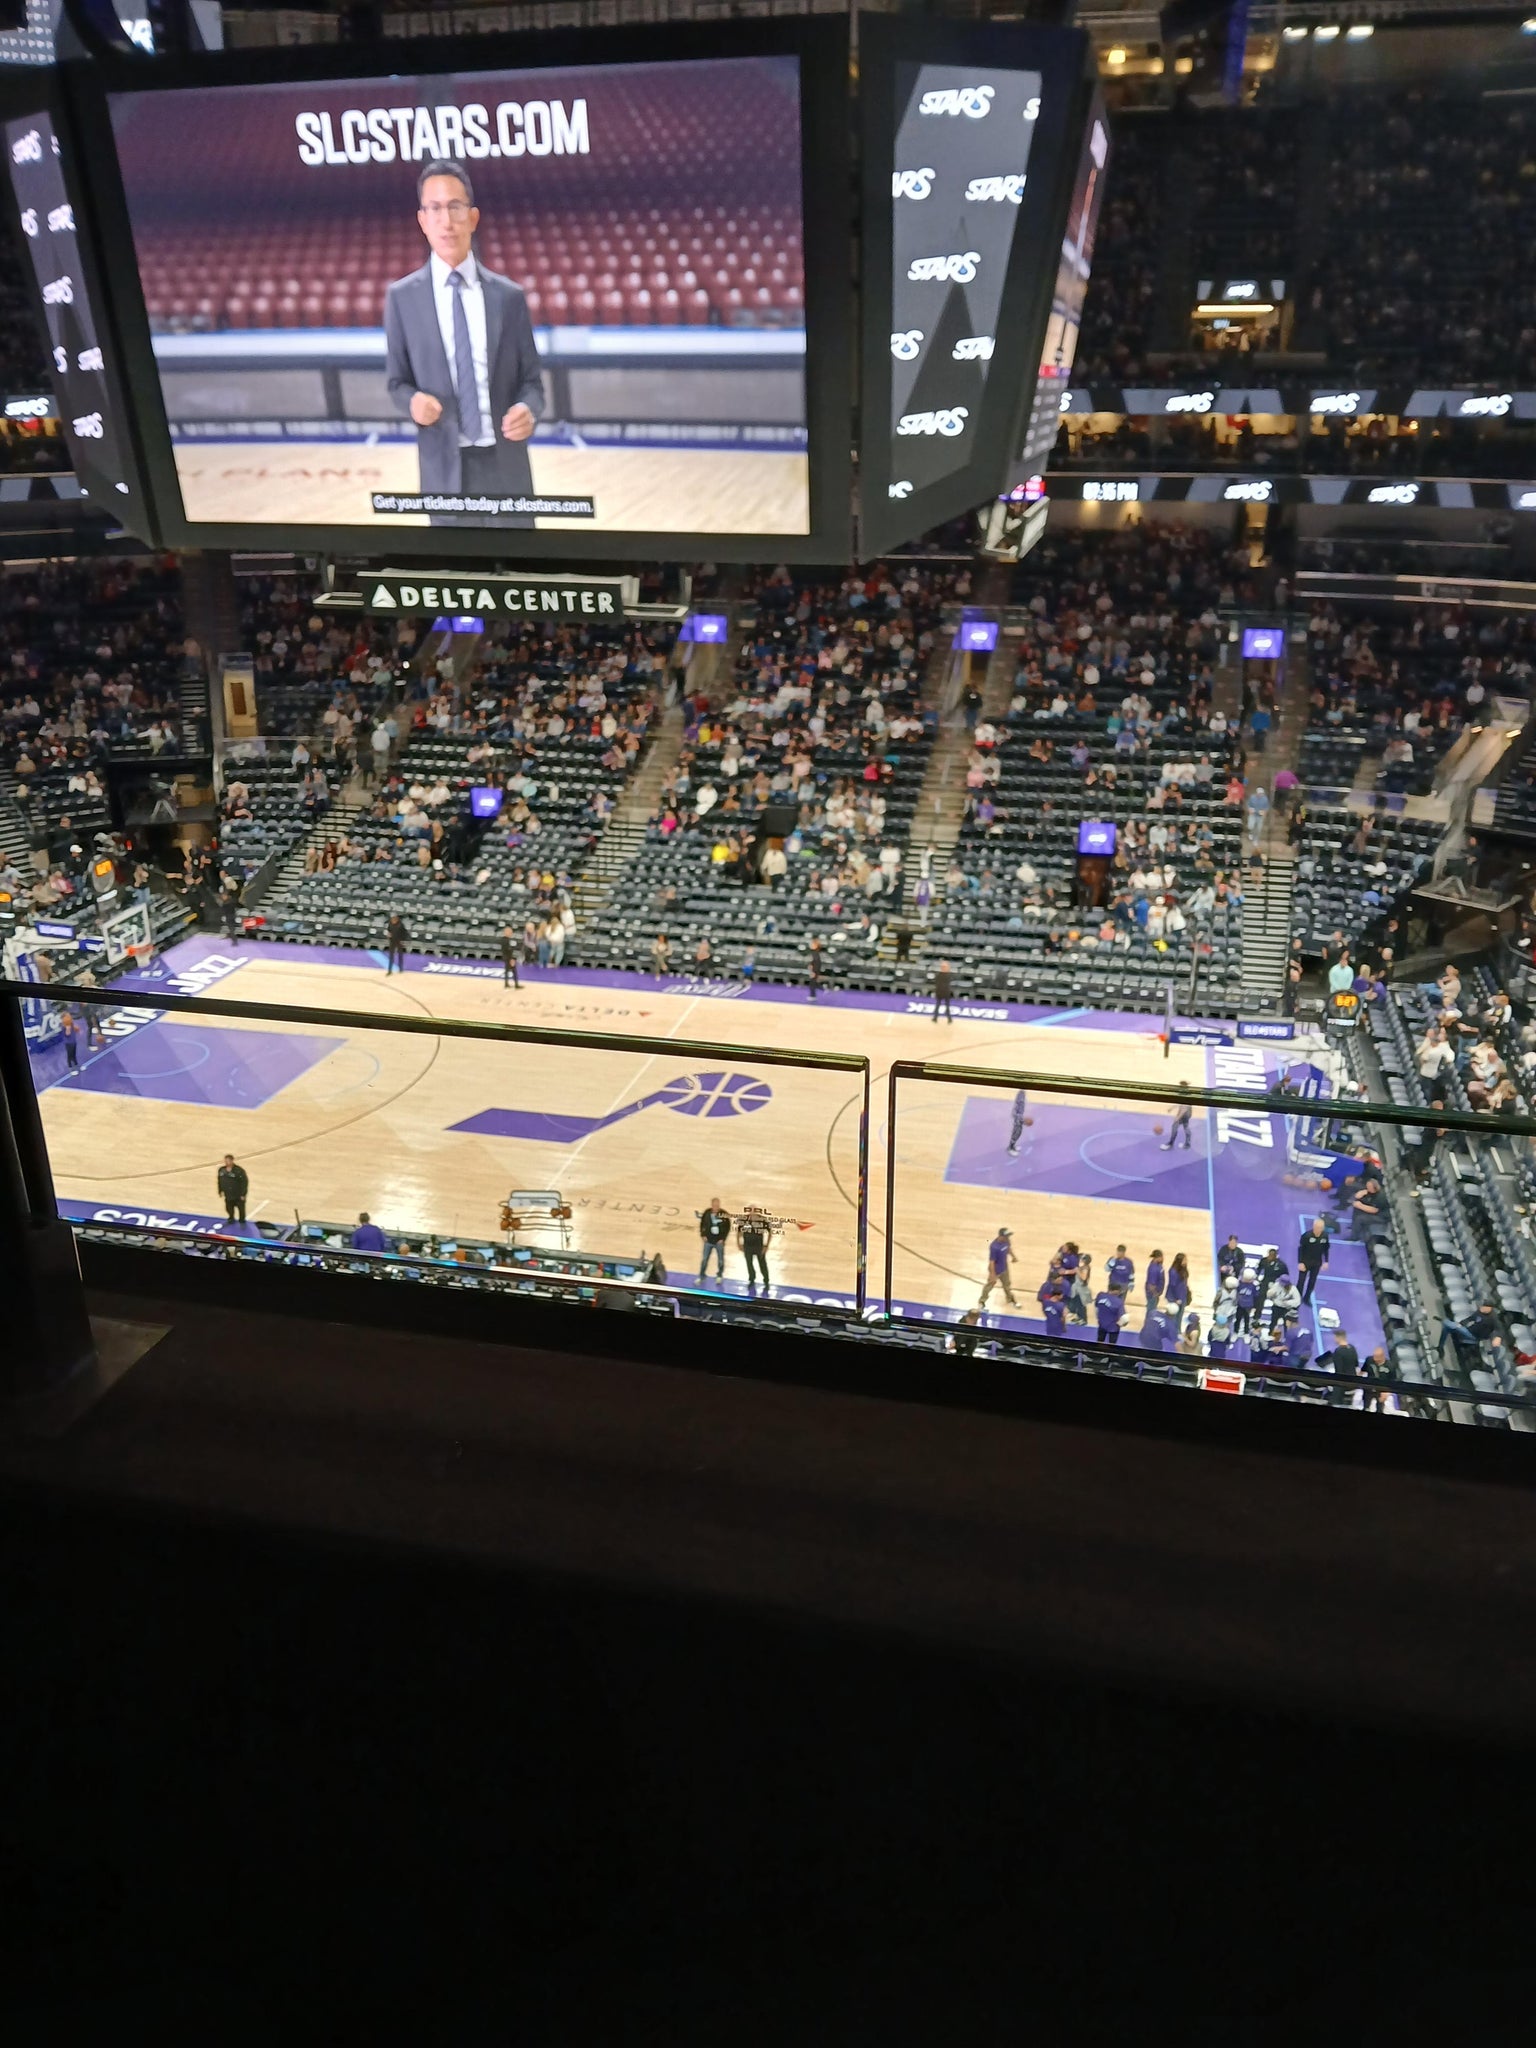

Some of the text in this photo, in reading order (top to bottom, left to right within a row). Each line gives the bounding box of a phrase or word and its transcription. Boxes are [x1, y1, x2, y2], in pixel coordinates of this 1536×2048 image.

[919, 85, 996, 119] STARS
[295, 98, 590, 165] SLCSTARS.COM
[908, 252, 982, 284] STARS
[897, 407, 969, 437] STARS
[373, 494, 397, 509] Get
[396, 498, 422, 512] your
[423, 495, 465, 511] tickets
[465, 497, 499, 514] today
[500, 498, 514, 511] at
[400, 586, 614, 614] DELTA CENTER
[166, 954, 249, 993] JAZZ
[577, 1198, 680, 1217] CENTER
[743, 1206, 772, 1216] PRL
